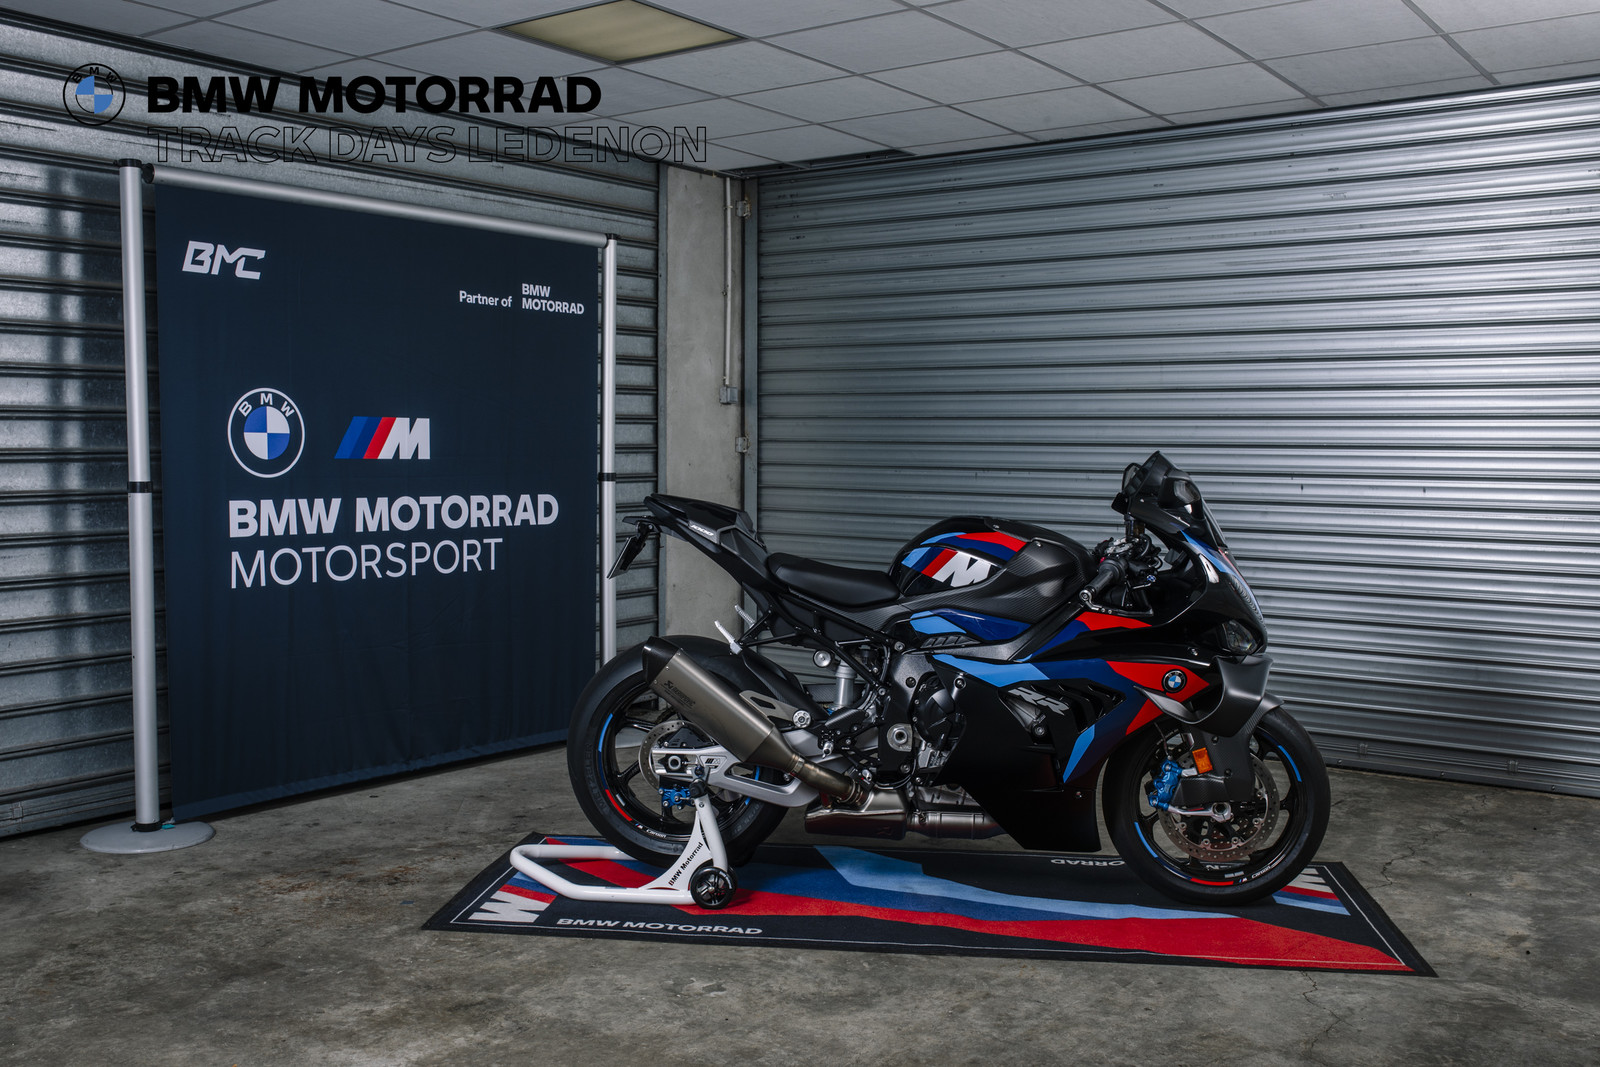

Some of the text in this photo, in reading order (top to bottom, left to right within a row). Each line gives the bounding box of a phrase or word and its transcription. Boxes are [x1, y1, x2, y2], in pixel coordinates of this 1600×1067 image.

[182, 240, 266, 280] BMC
[459, 291, 513, 308] Partner of
[522, 283, 551, 297] BMW
[522, 298, 585, 314] MOTORRAD
[238, 393, 295, 418] BMW
[228, 494, 560, 538] BMW MOTORRAD
[231, 538, 503, 589] MOTORSPORT
[1007, 686, 1071, 716] RR
[668, 869, 682, 886] BMW
[680, 842, 704, 871] Motorrad
[1051, 859, 1125, 868] ORRAD
[557, 918, 763, 936] BMW MOTORRAD
